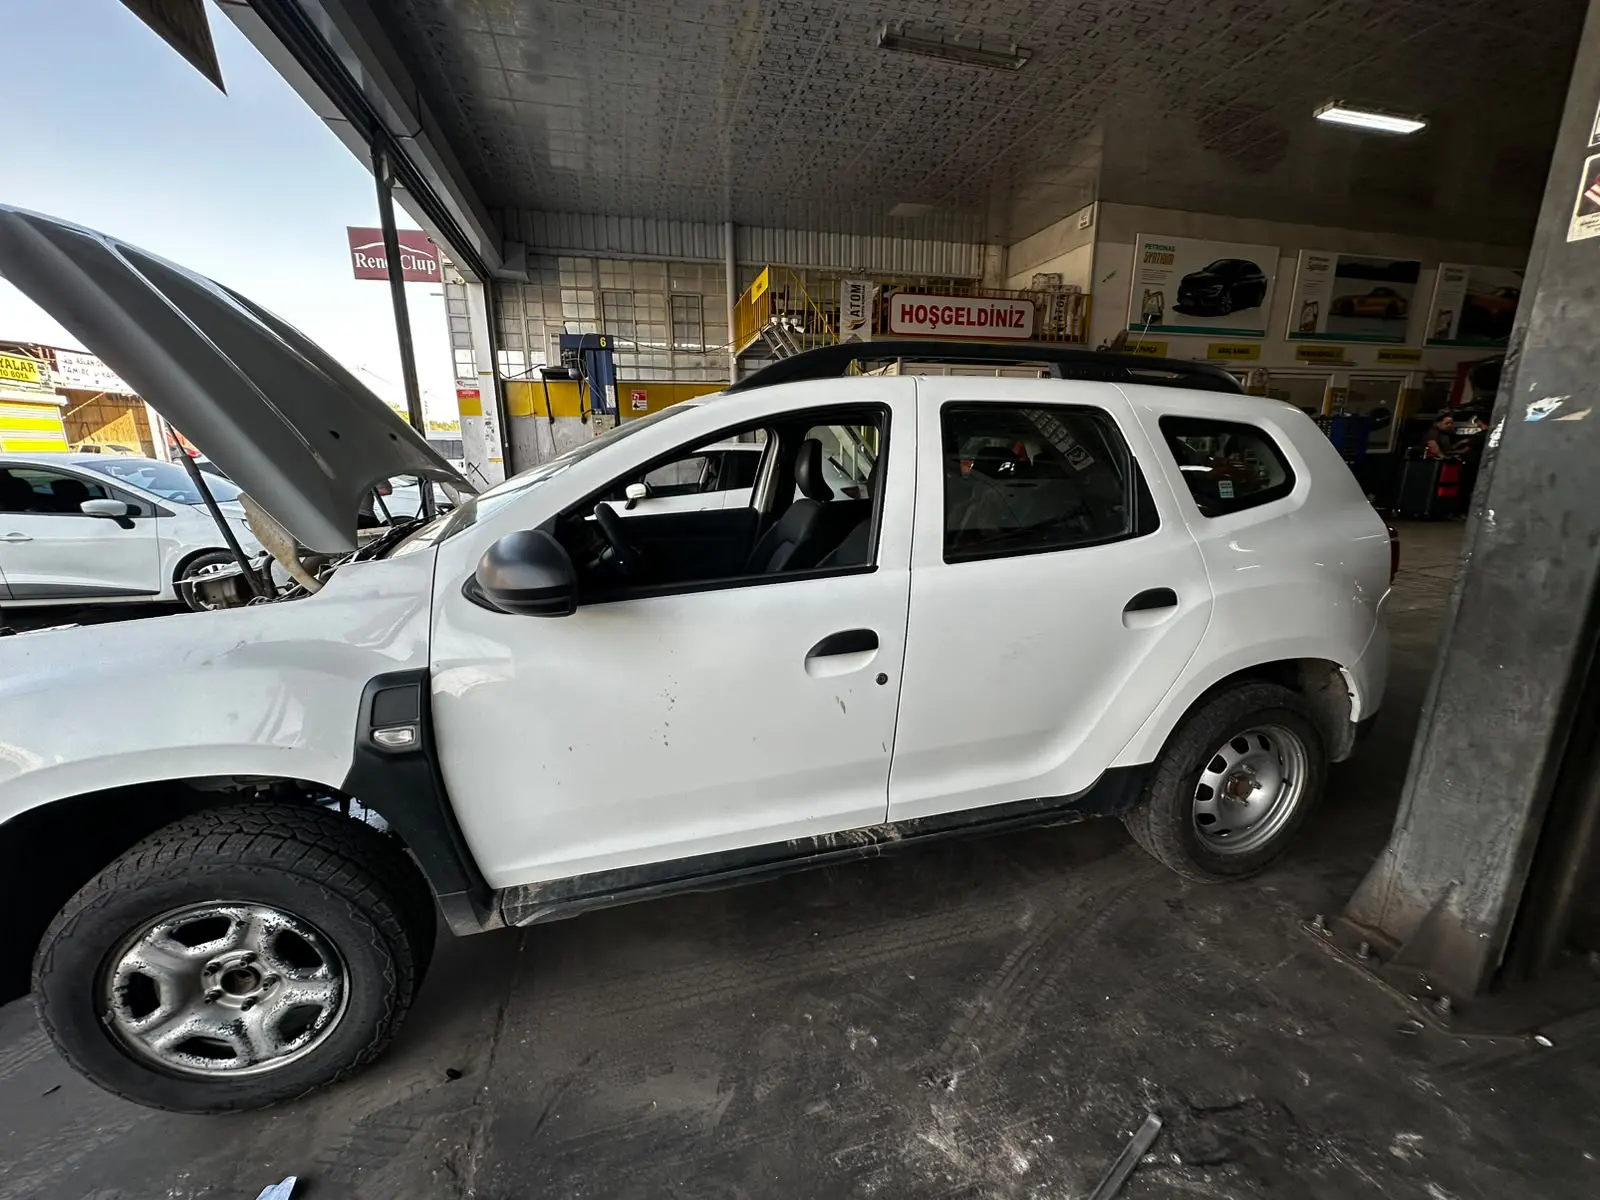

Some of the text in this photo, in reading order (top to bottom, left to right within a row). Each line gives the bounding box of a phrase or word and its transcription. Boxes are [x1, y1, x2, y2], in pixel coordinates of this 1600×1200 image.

[354, 252, 436, 275] Ren Clup
[850, 284, 861, 317] ATOM
[901, 303, 1025, 330] HOŞGELDİNİZ
[600, 336, 606, 347] 6
